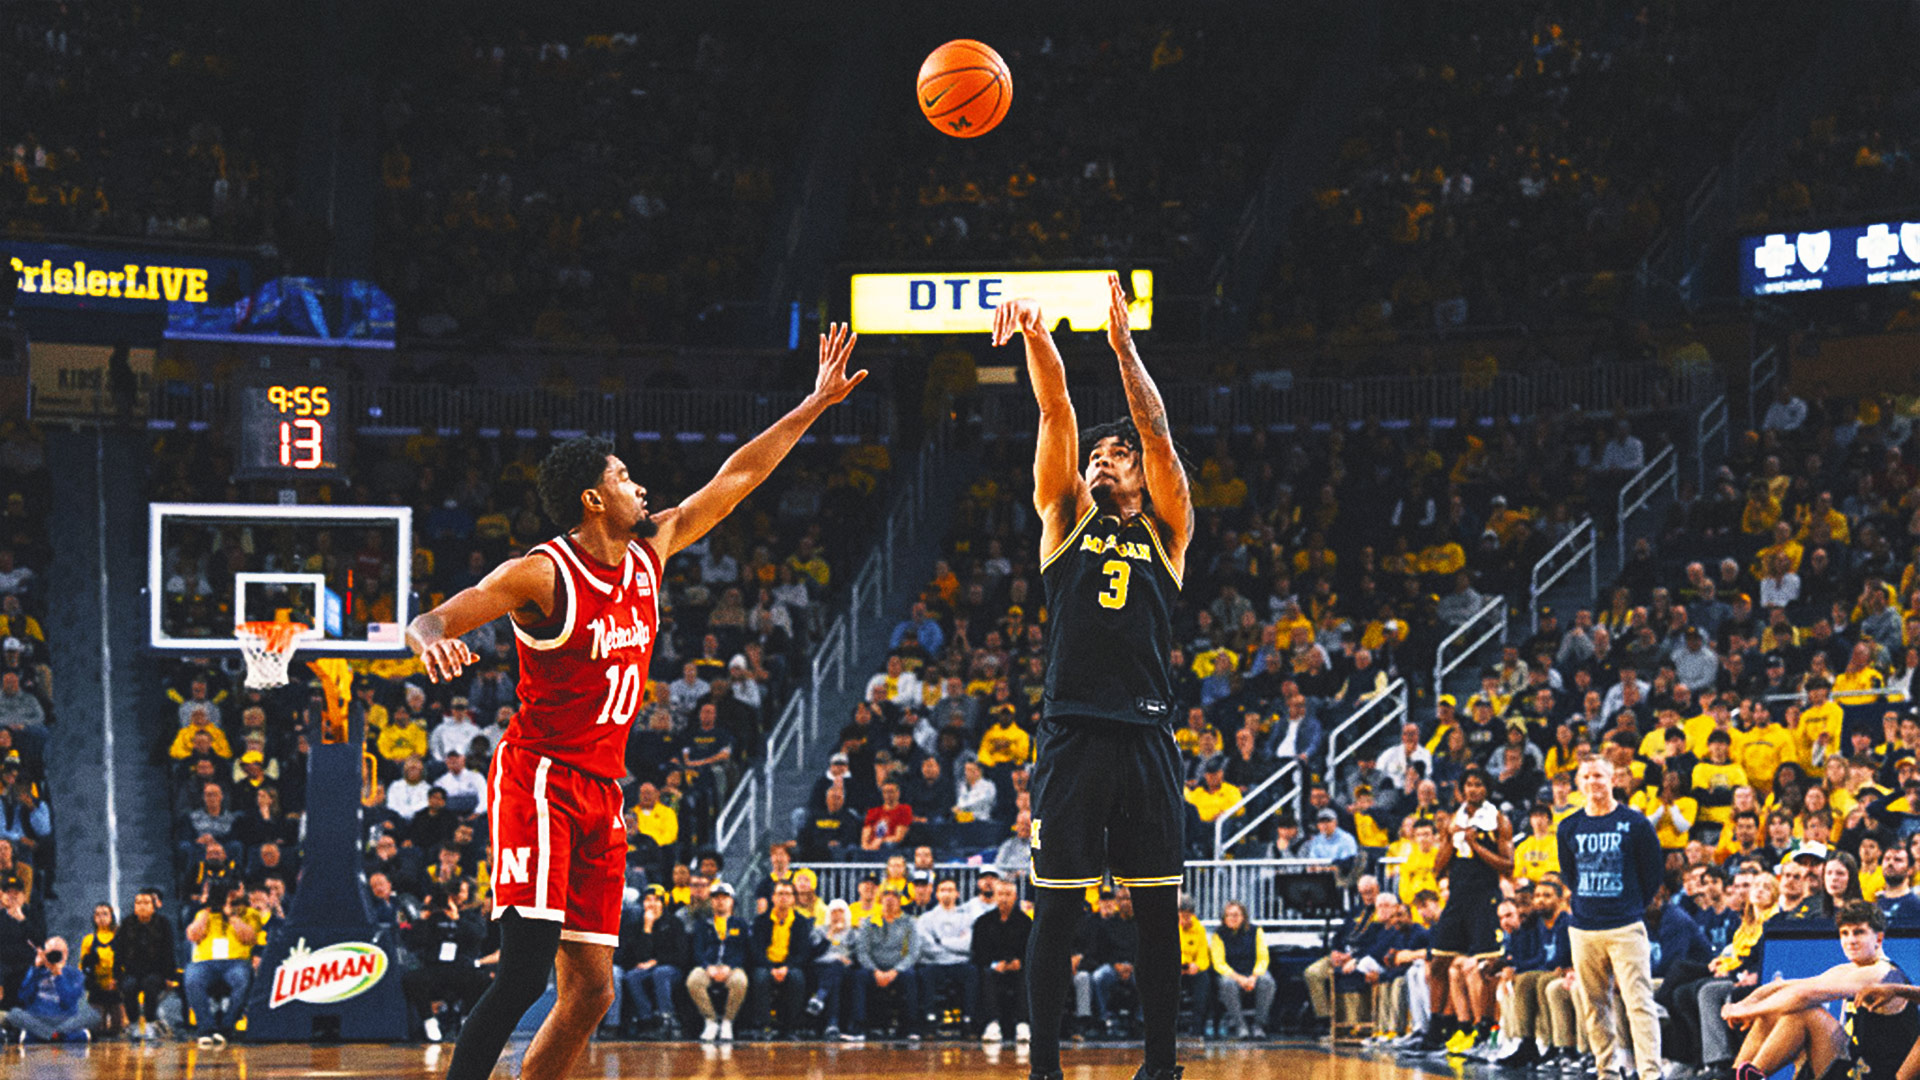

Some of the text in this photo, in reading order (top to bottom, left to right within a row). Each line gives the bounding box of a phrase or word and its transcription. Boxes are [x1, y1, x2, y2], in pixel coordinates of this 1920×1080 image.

[910, 279, 1003, 310] DTE
[267, 386, 331, 416] 9:55
[279, 418, 323, 469] 13
[1098, 559, 1131, 609] 3
[596, 664, 640, 725] 10
[1575, 832, 1622, 853] YOUR
[499, 847, 531, 884] N
[274, 953, 376, 1002] LIBMAN
